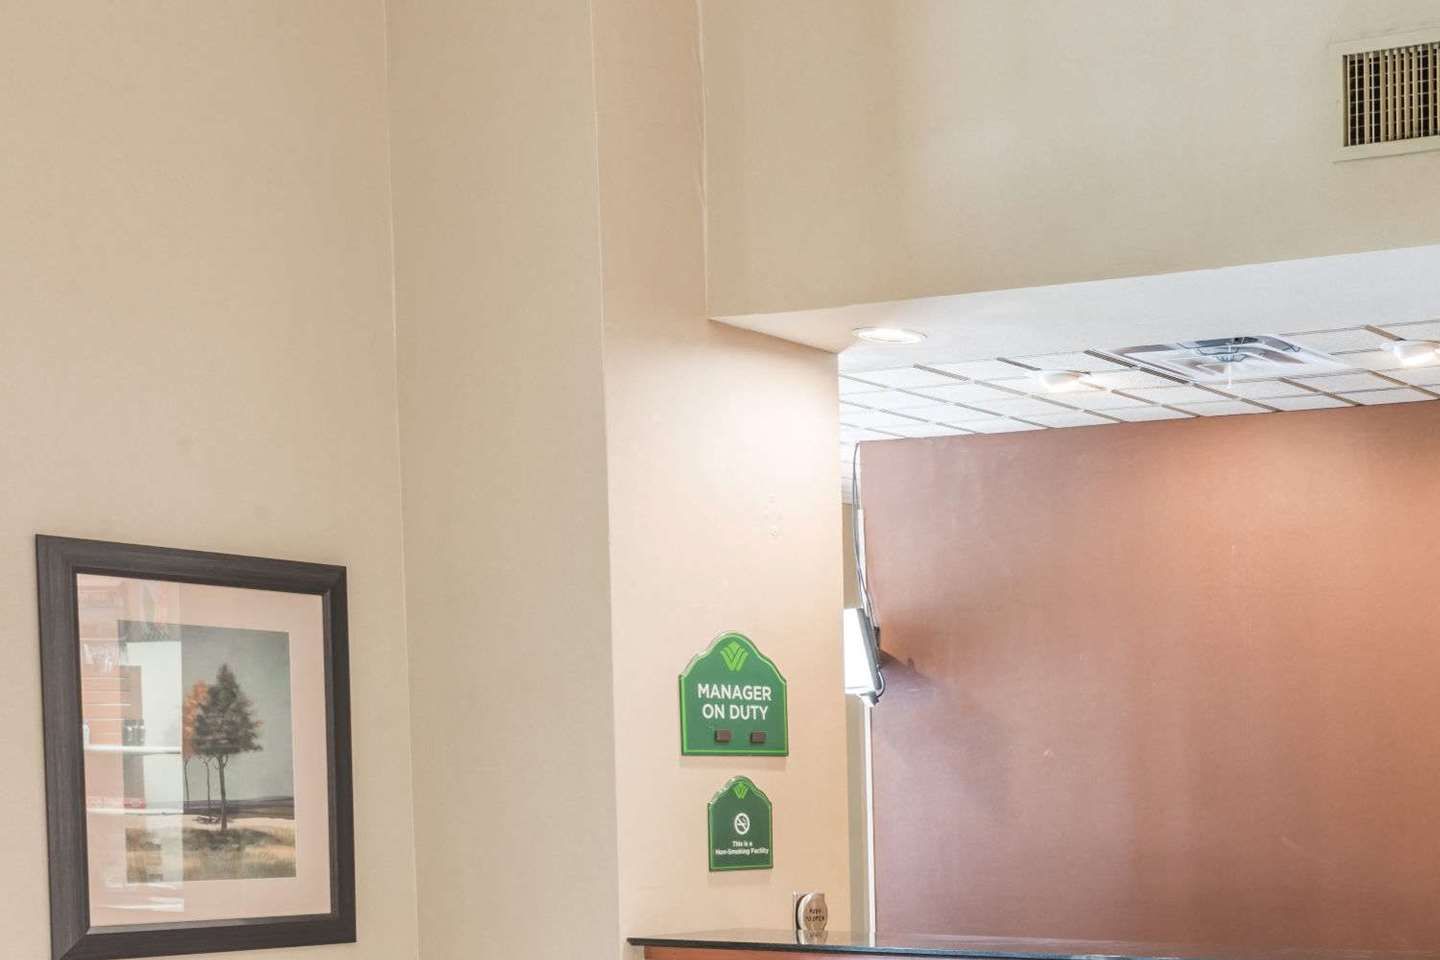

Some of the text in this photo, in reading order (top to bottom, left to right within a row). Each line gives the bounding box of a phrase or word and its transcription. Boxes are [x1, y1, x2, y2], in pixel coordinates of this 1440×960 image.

[697, 683, 772, 701] MANAGER
[702, 703, 768, 720] ON DUTY
